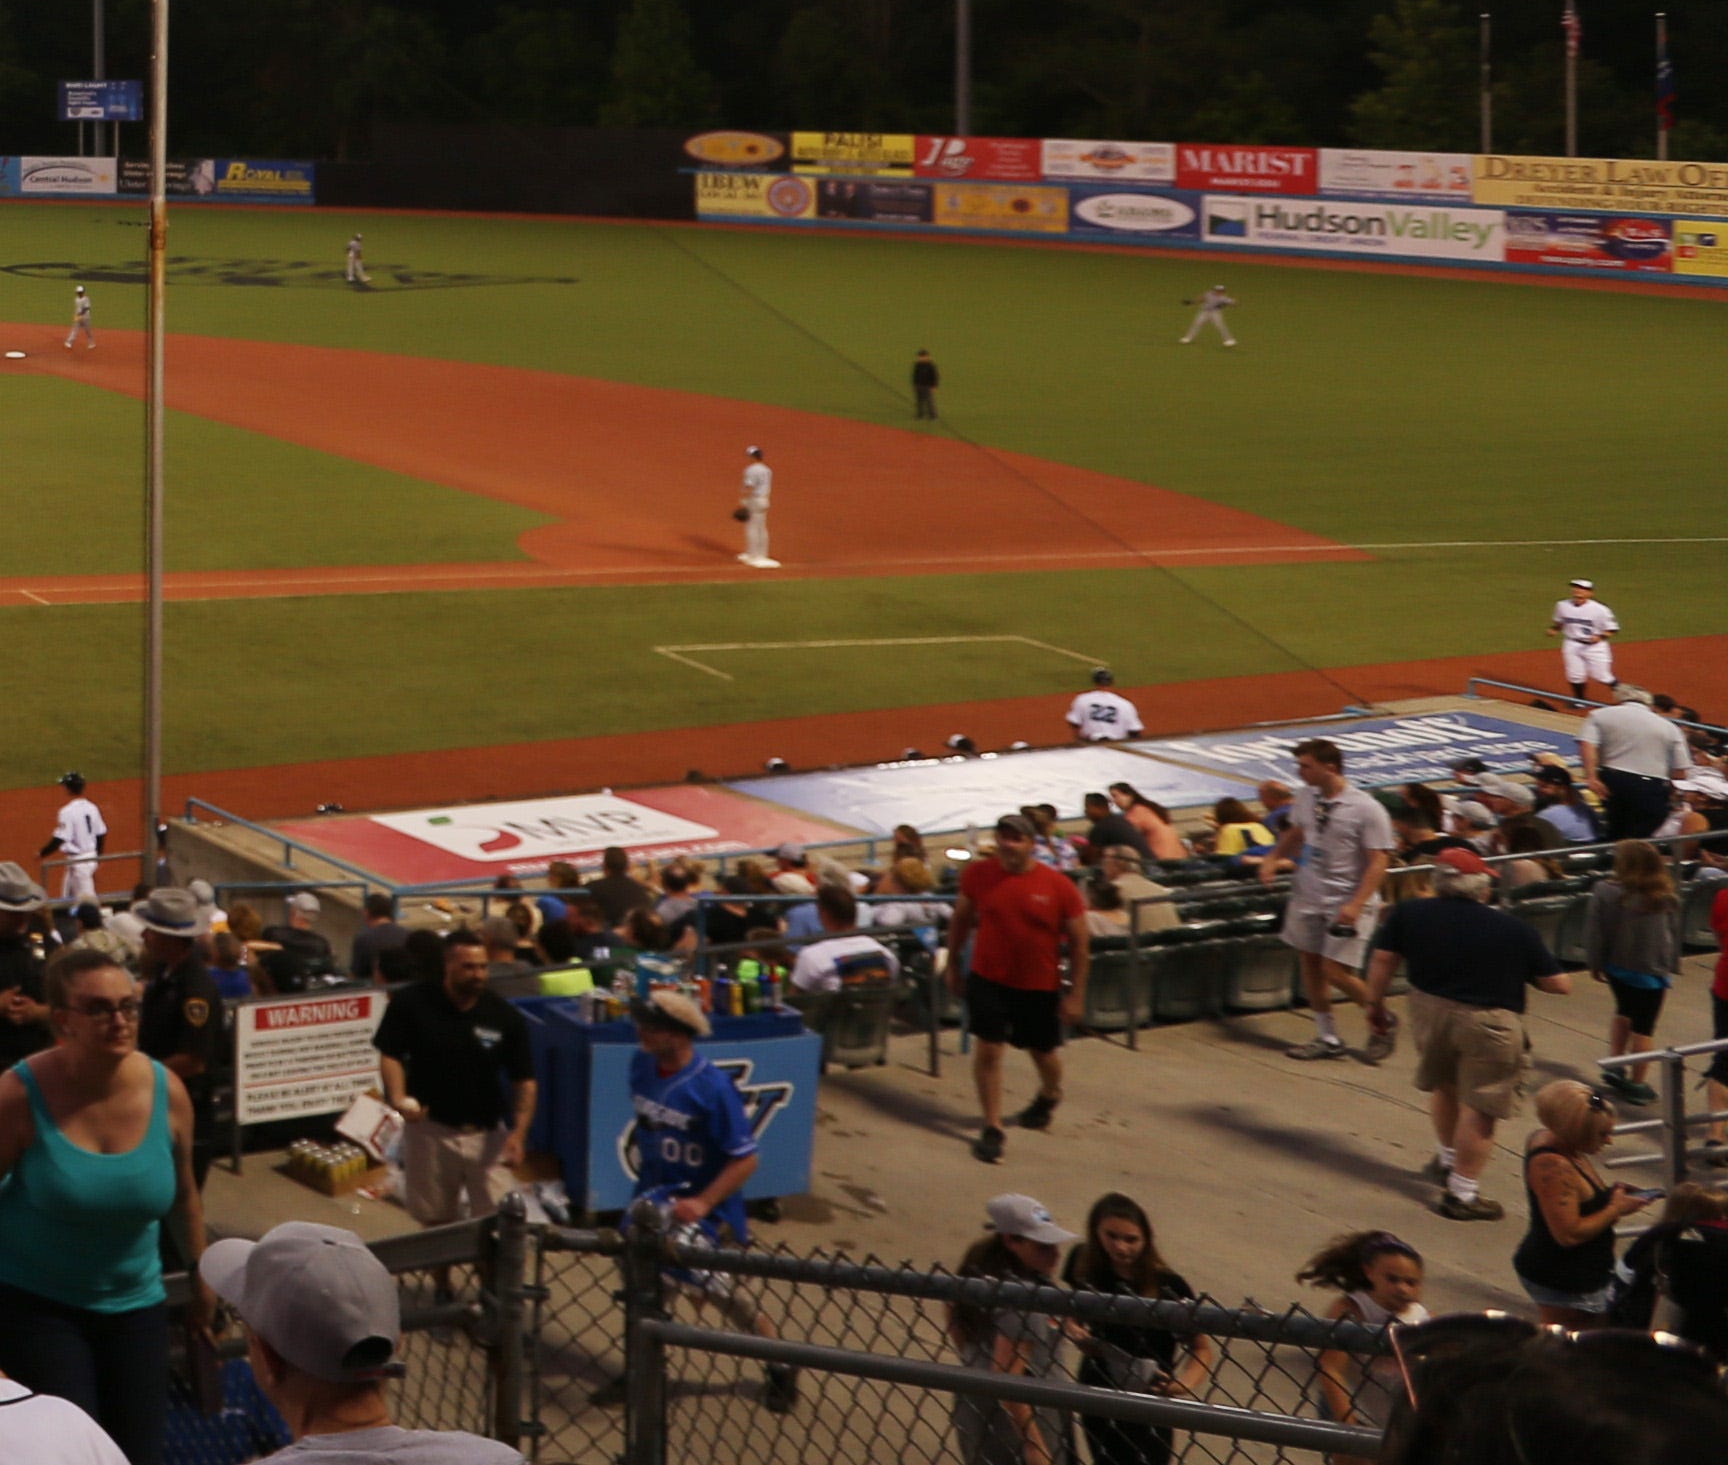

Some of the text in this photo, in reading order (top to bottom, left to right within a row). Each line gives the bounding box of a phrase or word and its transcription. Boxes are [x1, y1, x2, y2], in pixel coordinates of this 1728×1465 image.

[226, 162, 281, 181] ROYAL
[1182, 150, 1314, 176] MARIST
[1484, 157, 1600, 179] DREYER
[1607, 161, 1672, 184] LAW
[29, 174, 94, 184] Central Hudson
[1090, 703, 1117, 724] 22
[505, 811, 639, 840] MVP
[267, 1000, 360, 1025] WARNING
[662, 1137, 704, 1167] 00
